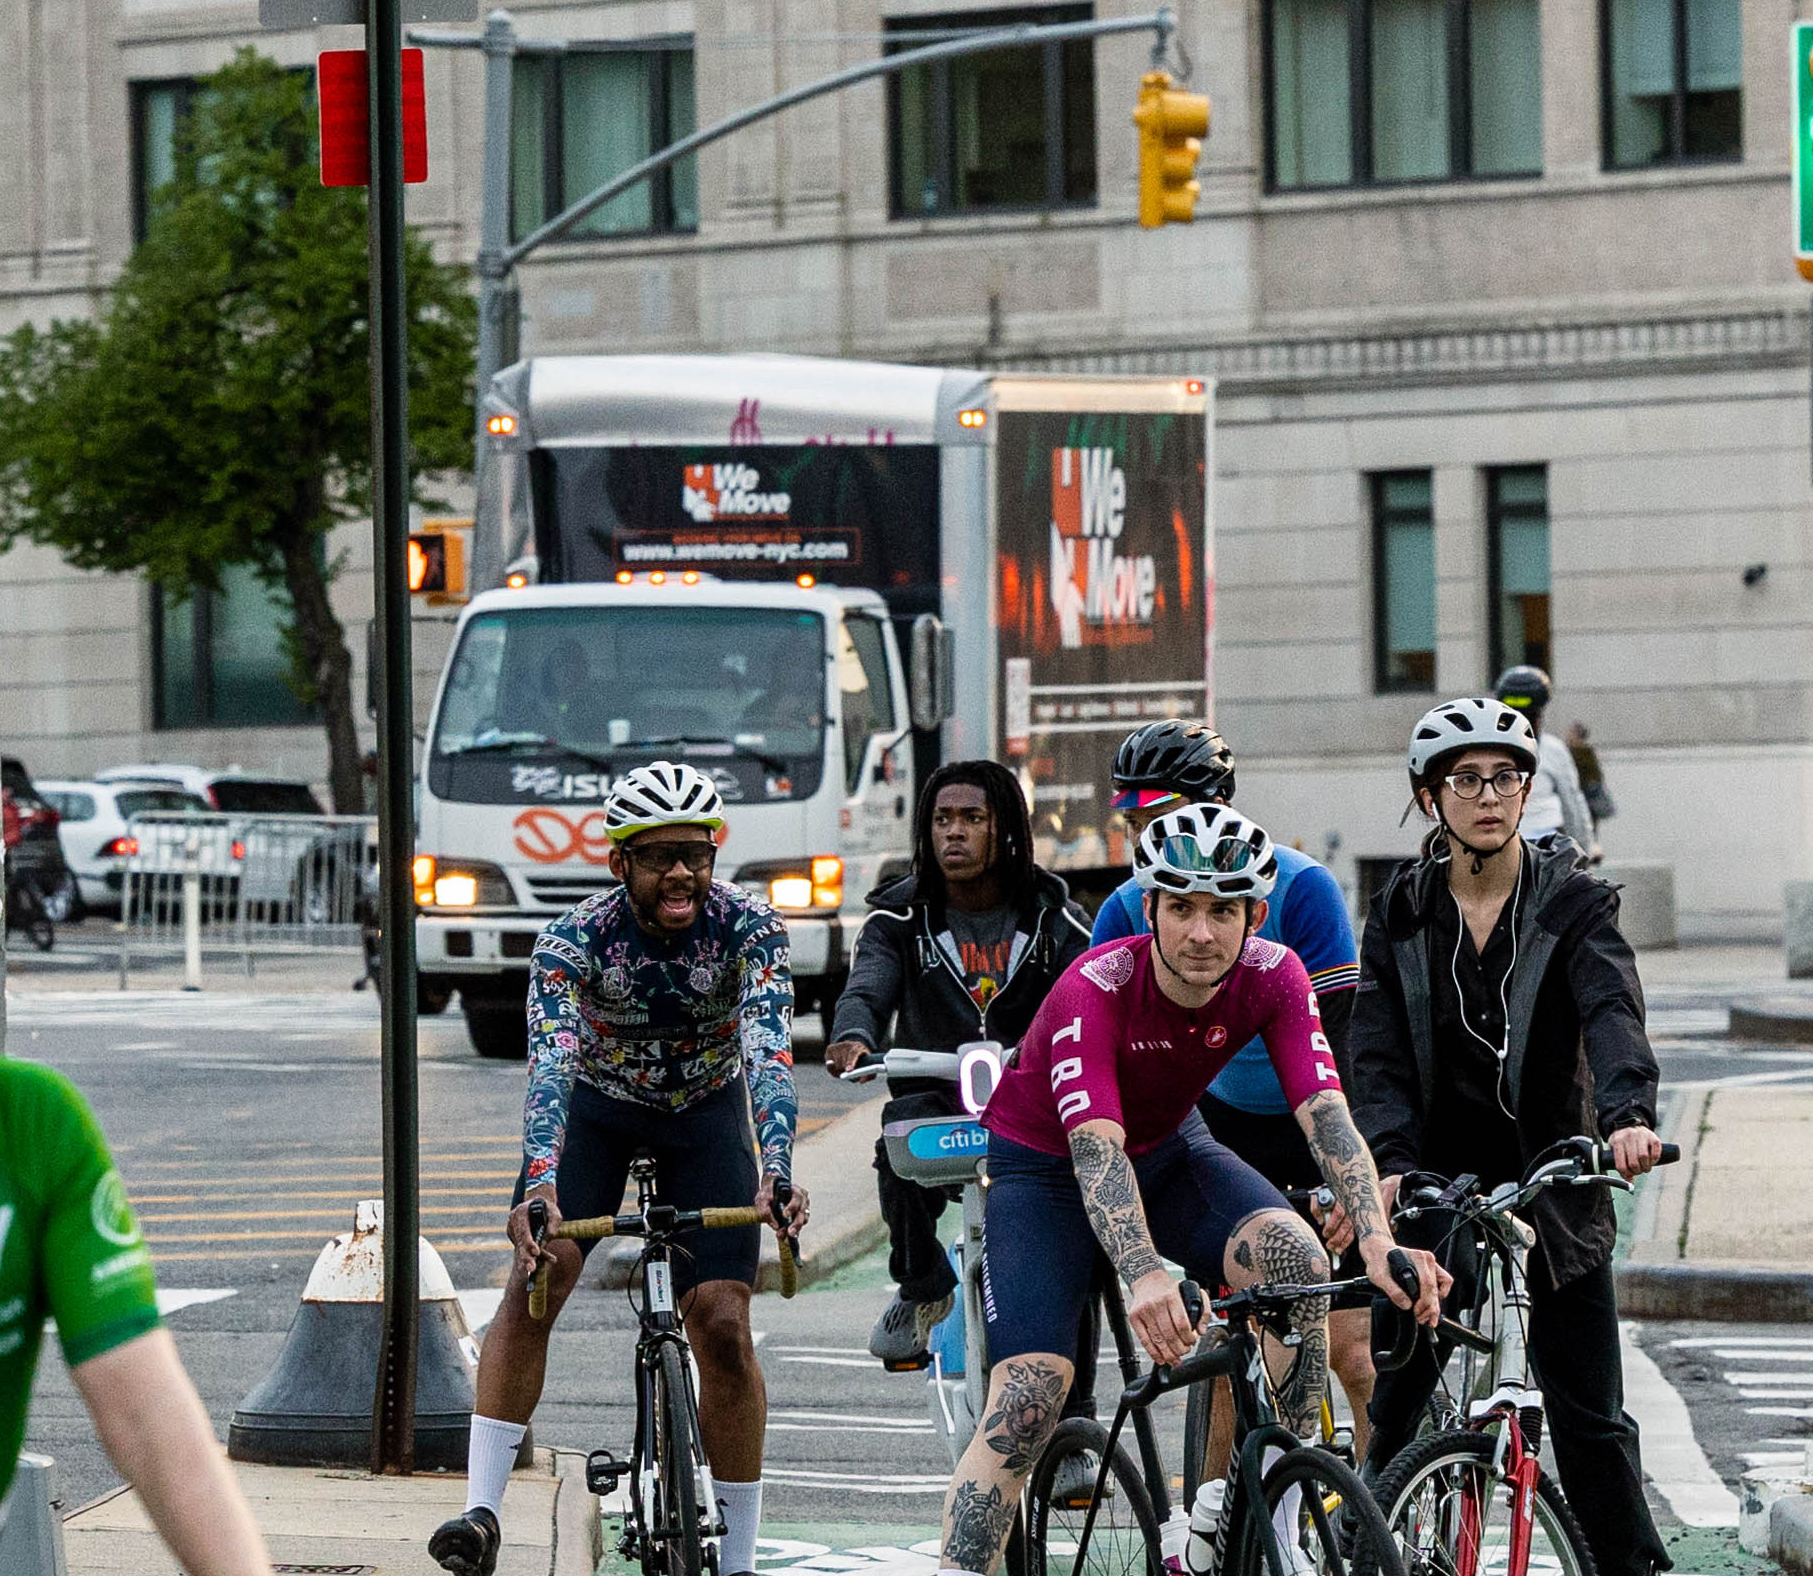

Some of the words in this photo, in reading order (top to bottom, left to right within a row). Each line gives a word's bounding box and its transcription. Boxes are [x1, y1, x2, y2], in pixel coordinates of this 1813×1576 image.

[713, 464, 760, 490] We
[719, 493, 792, 514] Move
[1080, 447, 1127, 539] We
[623, 542, 849, 564] www.wemove-nyc.com
[1087, 537, 1156, 620] Move
[563, 774, 614, 798] ISU
[939, 1131, 969, 1149] citi
[971, 1130, 990, 1146] bi
